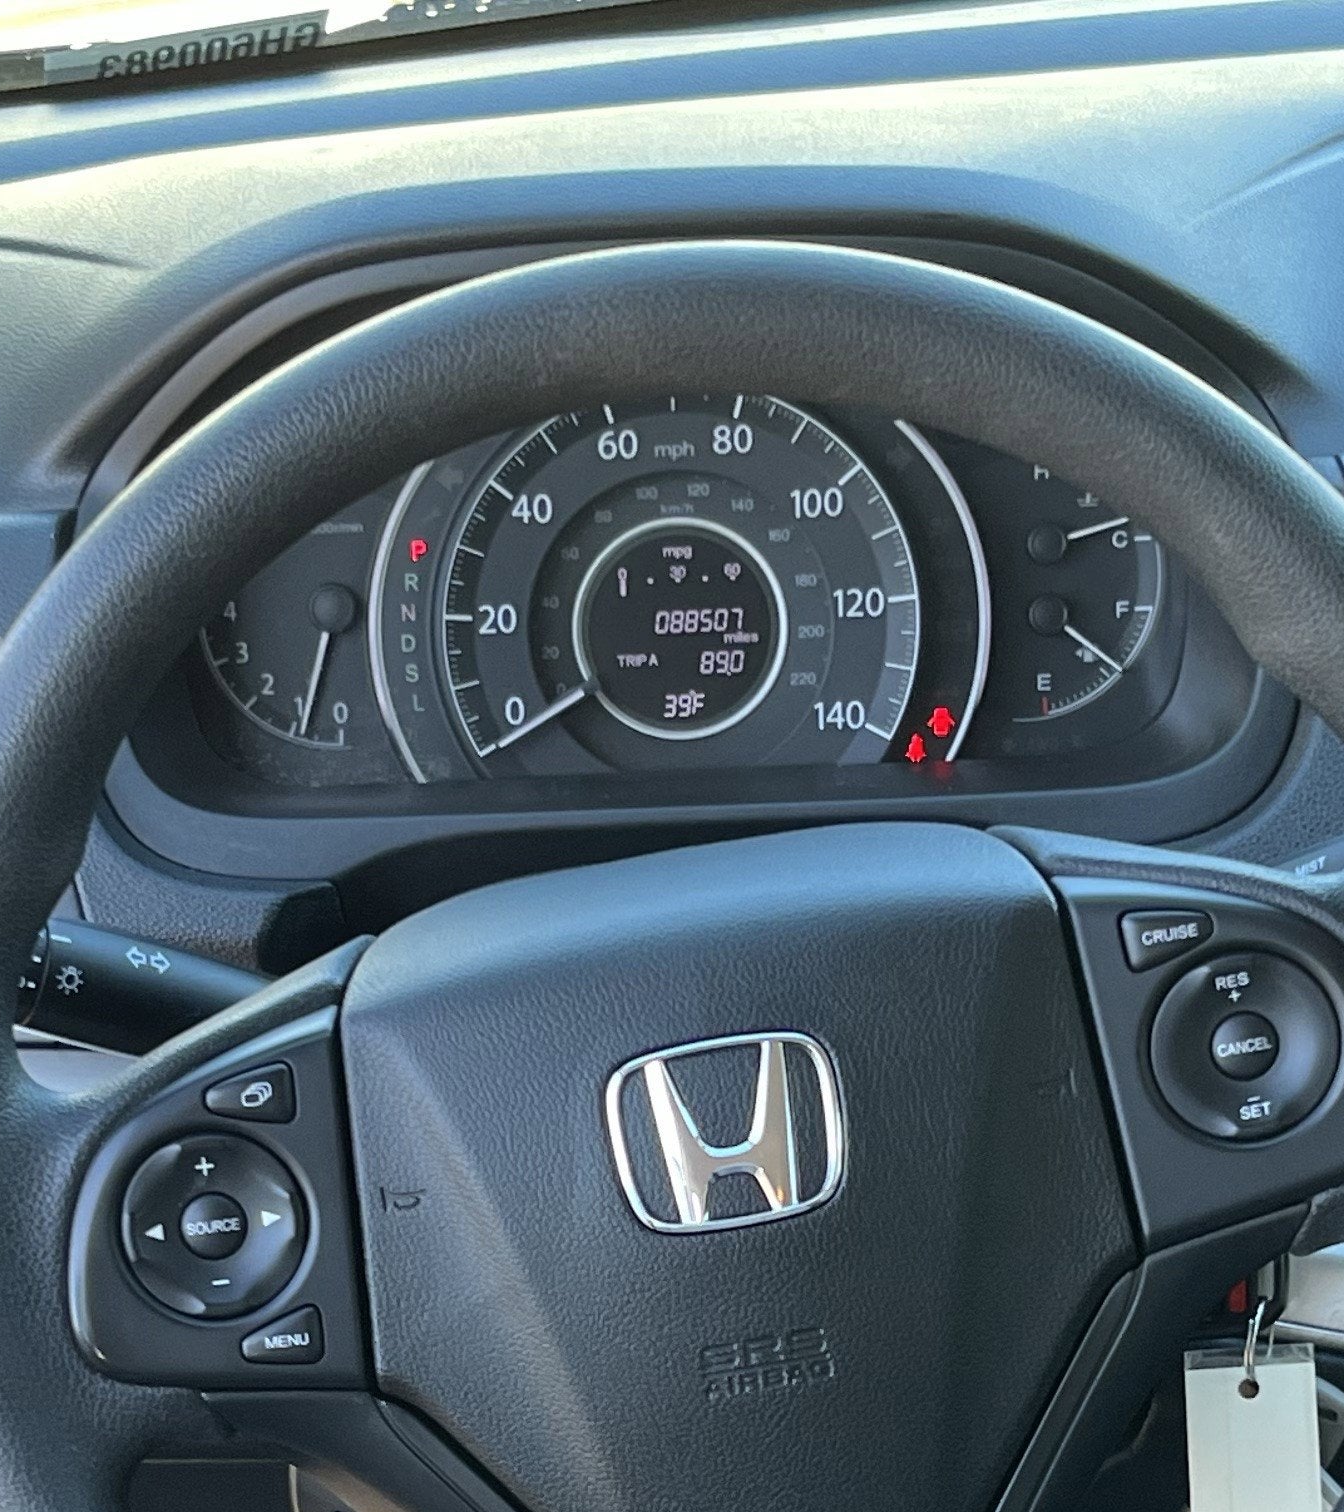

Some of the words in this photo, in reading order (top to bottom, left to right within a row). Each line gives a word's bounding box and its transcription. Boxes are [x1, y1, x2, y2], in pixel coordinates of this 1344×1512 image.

[597, 429, 638, 461] 60
[712, 423, 754, 456] 80
[654, 440, 695, 462] mph
[511, 493, 553, 525] 40
[789, 486, 844, 520] 100
[409, 538, 428, 563] P
[1112, 530, 1129, 549] C
[662, 545, 693, 560] mpg
[404, 573, 419, 592] R
[222, 601, 237, 622] 4
[401, 604, 416, 622] N
[832, 587, 885, 620] 120
[1115, 600, 1129, 619] F
[479, 604, 517, 635] 20
[655, 608, 744, 635] 088507
[235, 642, 250, 664] 3
[401, 634, 416, 653] D
[617, 653, 647, 668] TRIP
[649, 653, 659, 667] A
[404, 663, 419, 683] S
[1037, 673, 1052, 691] E
[260, 673, 275, 696] 2
[331, 701, 348, 725] 0
[412, 694, 425, 712] L
[505, 695, 525, 726] 0
[813, 700, 866, 731] 140
[1141, 922, 1199, 946] CRUISE
[1215, 971, 1250, 991] RES
[1216, 1036, 1272, 1058] CANCEL
[1239, 1100, 1271, 1121] SET
[186, 1217, 241, 1235] SOURCE
[264, 1331, 310, 1350] MENU
